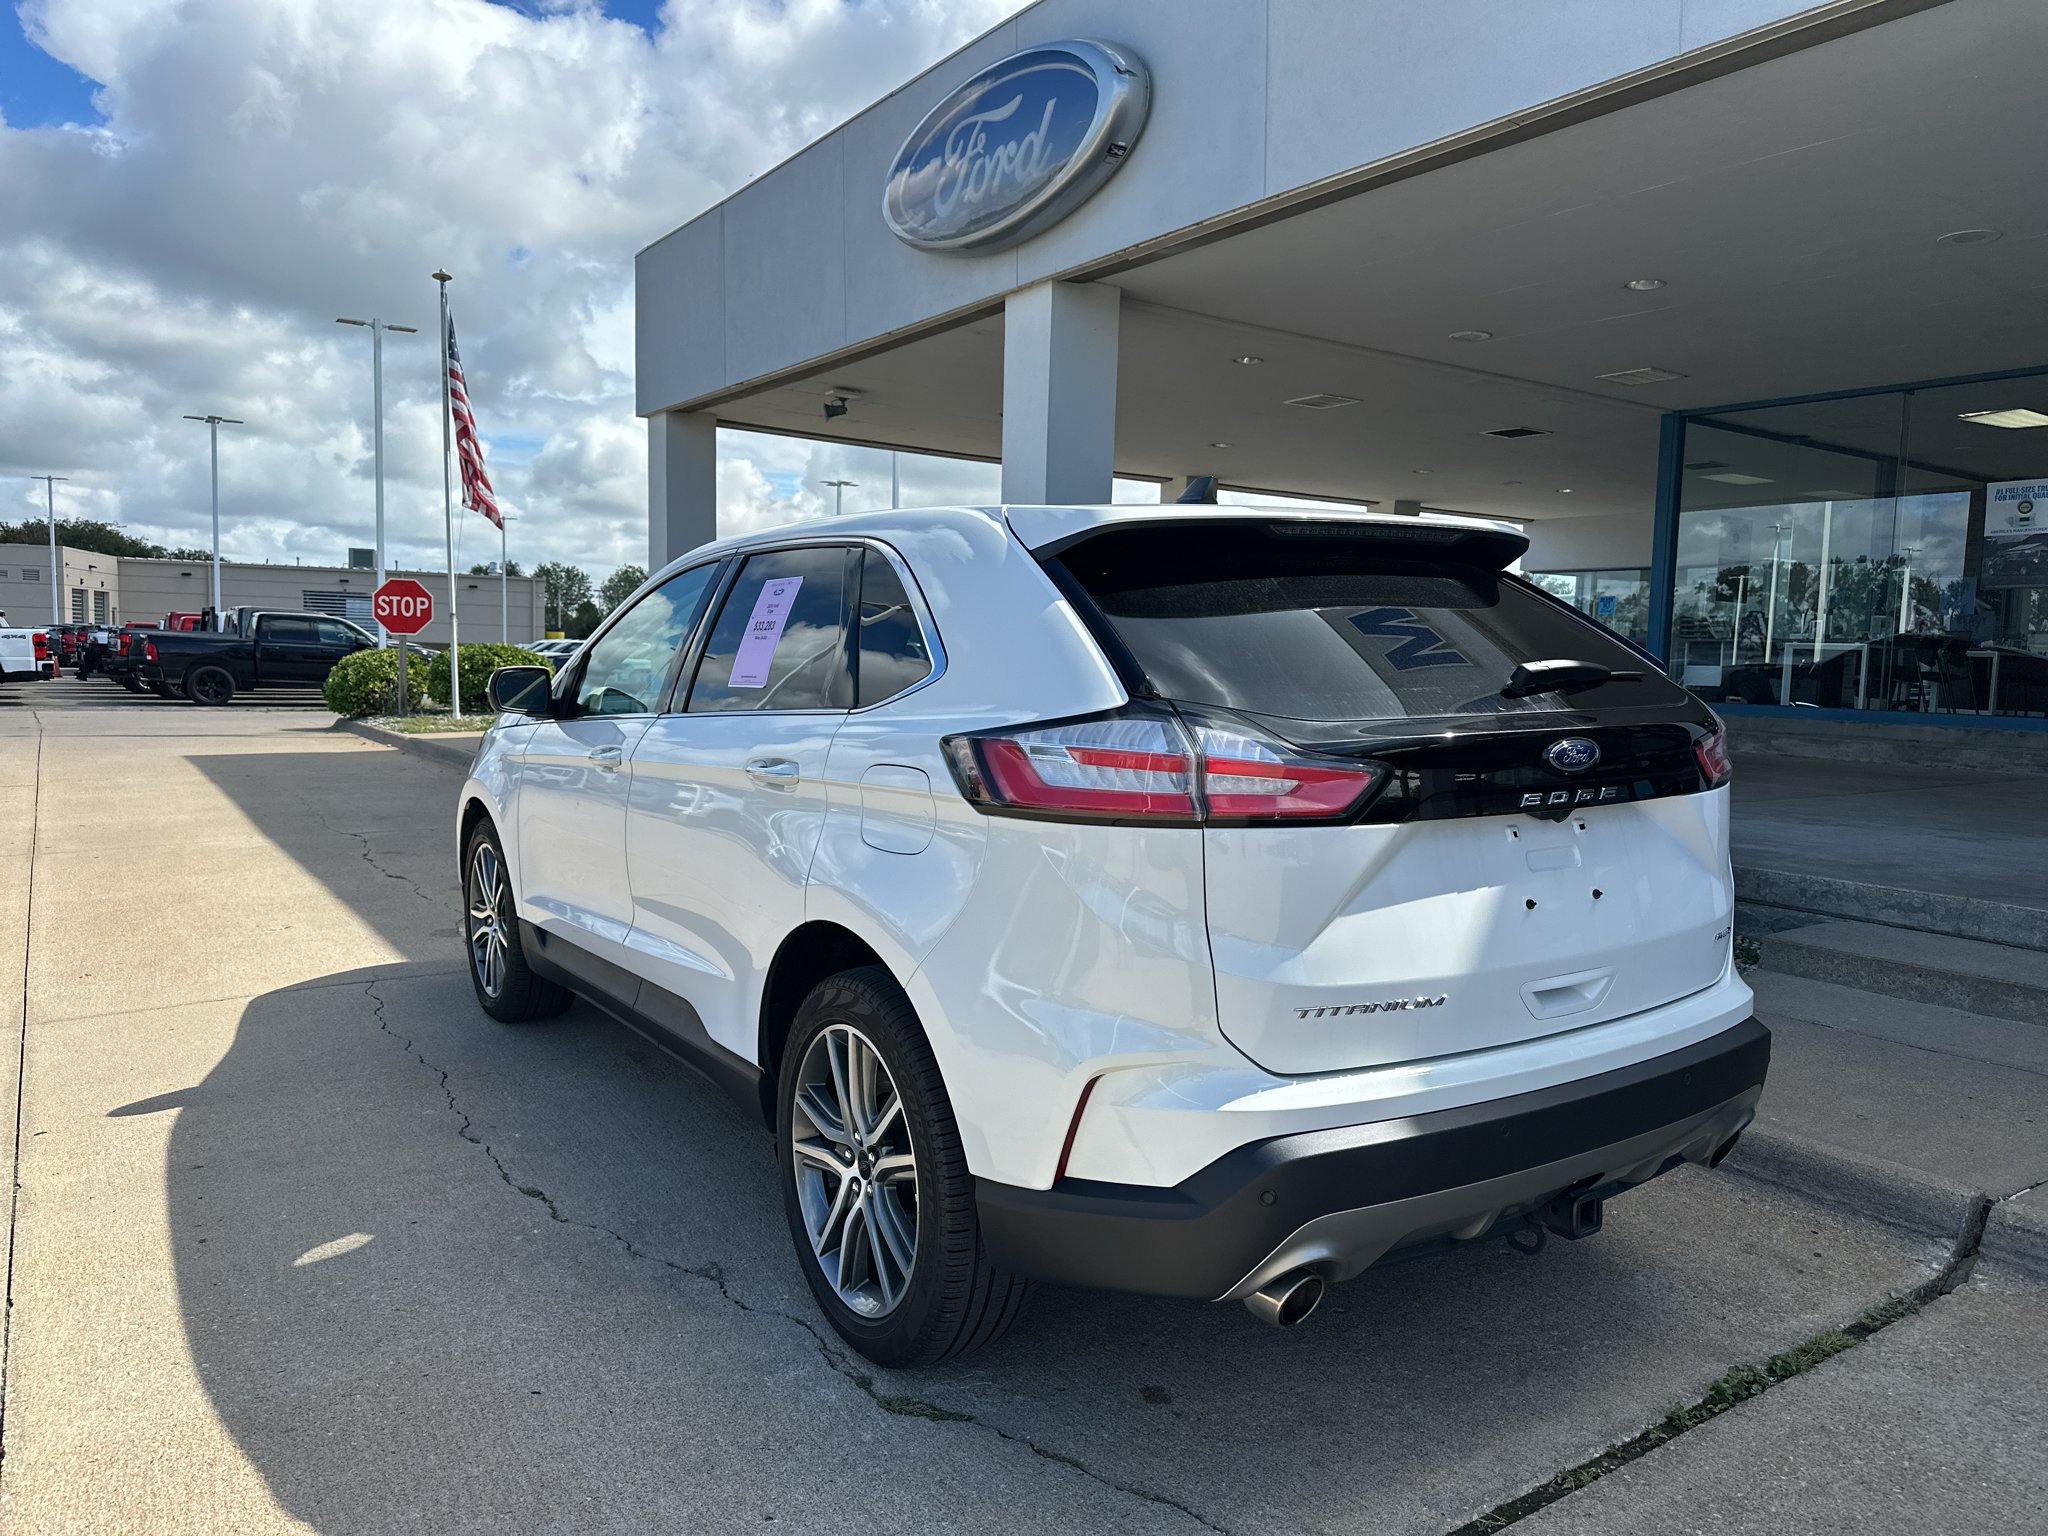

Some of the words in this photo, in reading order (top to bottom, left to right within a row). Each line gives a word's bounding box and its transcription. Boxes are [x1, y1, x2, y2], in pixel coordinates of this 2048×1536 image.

[933, 93, 1057, 217] Ford
[2005, 486, 2036, 495] FULL-SIZE
[377, 595, 429, 617] STOP
[1563, 745, 1592, 764] Ford
[1520, 786, 1618, 808] EDGE
[1294, 993, 1448, 1019] TITANIUM
